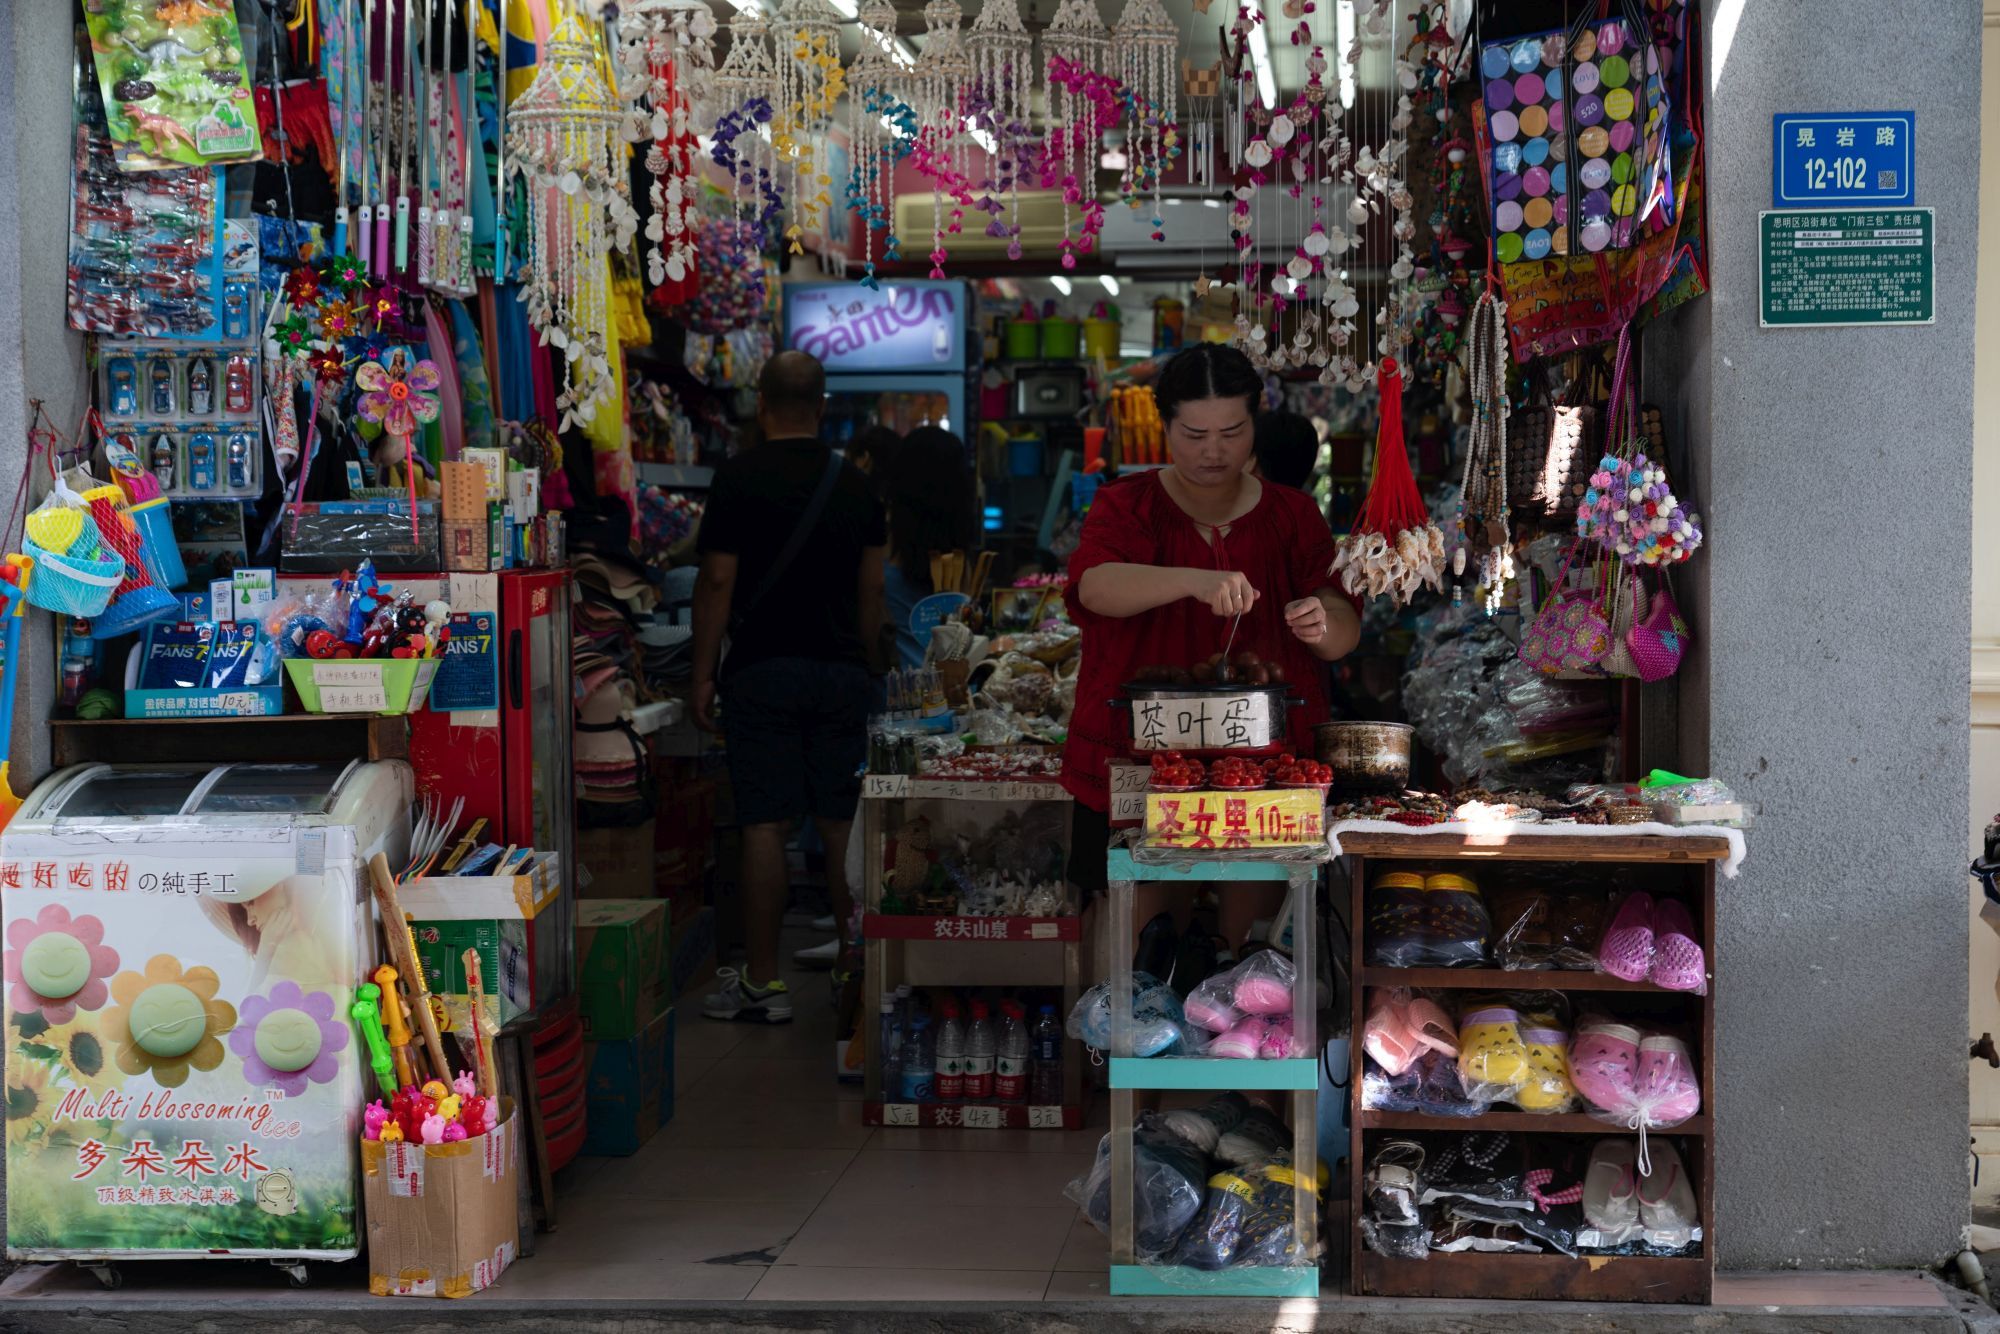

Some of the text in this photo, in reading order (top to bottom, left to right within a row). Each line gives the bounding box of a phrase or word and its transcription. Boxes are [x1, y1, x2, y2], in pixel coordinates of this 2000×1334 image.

[1580, 102, 1598, 119] 520
[1796, 127, 1896, 147] 晃岩路
[1805, 157, 1867, 189] 12-102
[790, 286, 956, 364] Ganten
[222, 695, 247, 709] 10元
[1141, 698, 1257, 750] 茶叶蛋
[1117, 797, 1144, 815] 10元
[1155, 797, 1251, 849] 圣女果
[934, 918, 1009, 939] 农夫山泉
[54, 1087, 283, 1132] Multi blossoming TM
[889, 1106, 916, 1125] 5元
[968, 1107, 992, 1126] 4元
[1031, 1107, 1057, 1127] 3元
[261, 1120, 301, 1138] ice
[71, 1138, 270, 1182] 多朵朵冰
[97, 1186, 241, 1205] 顶级精致冰淇淋
